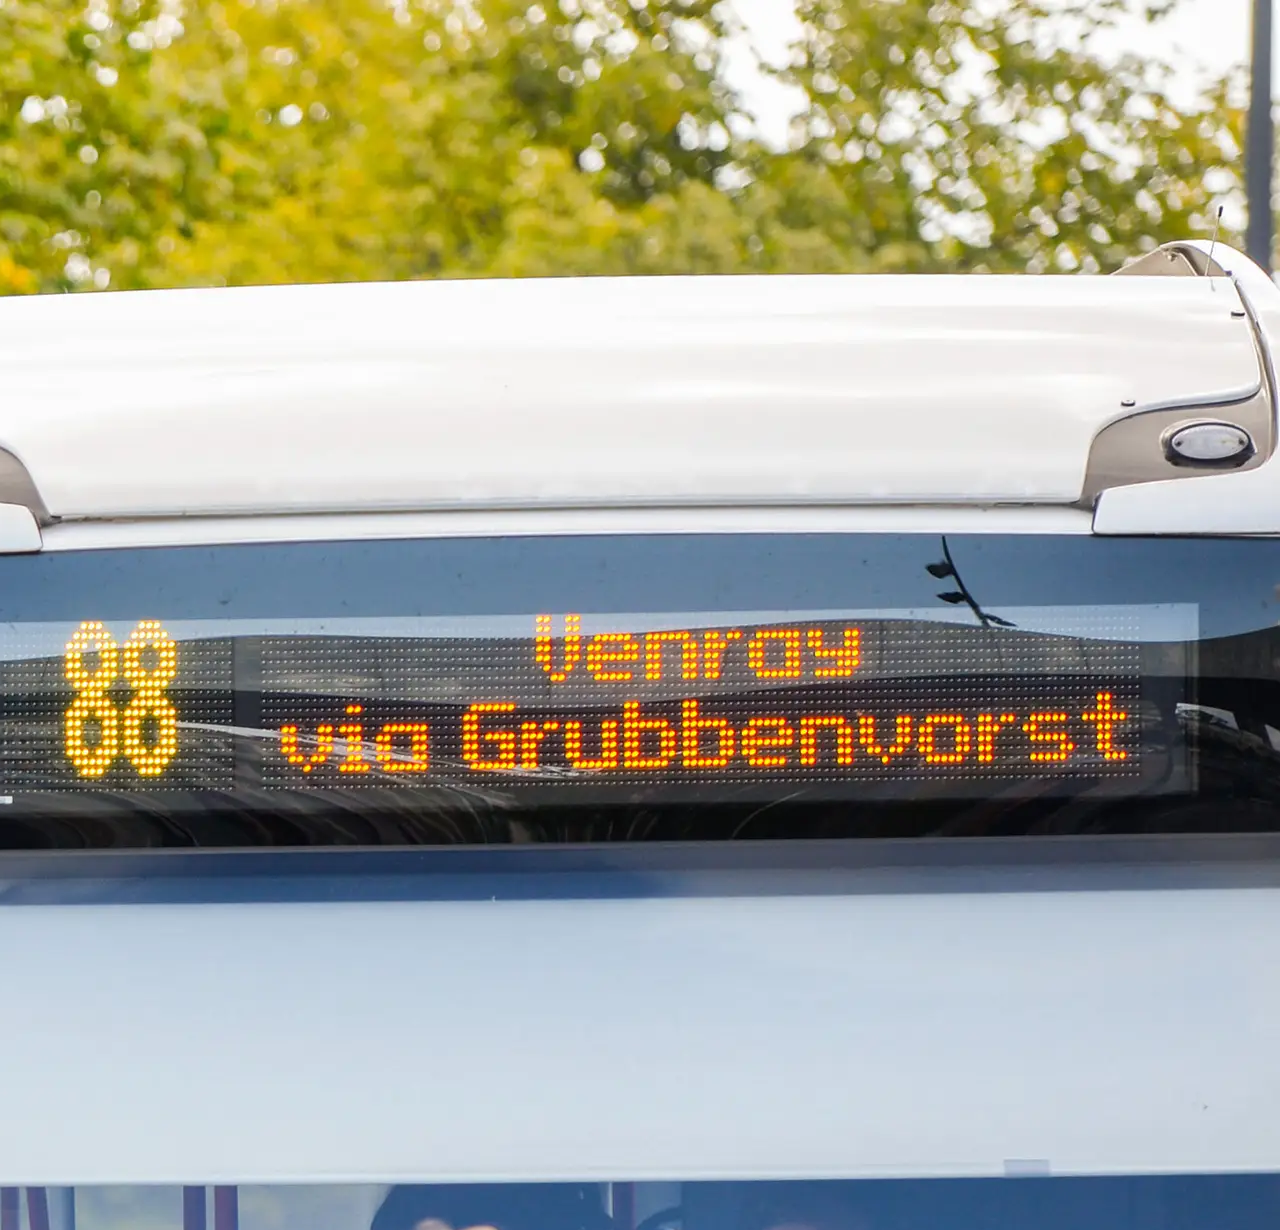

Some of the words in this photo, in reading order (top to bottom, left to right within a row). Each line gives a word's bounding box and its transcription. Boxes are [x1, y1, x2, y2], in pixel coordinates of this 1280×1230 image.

[535, 615, 861, 682] Venray
[64, 620, 177, 778] 88
[280, 703, 429, 772] via
[461, 692, 1128, 772] Grubbenvorst
